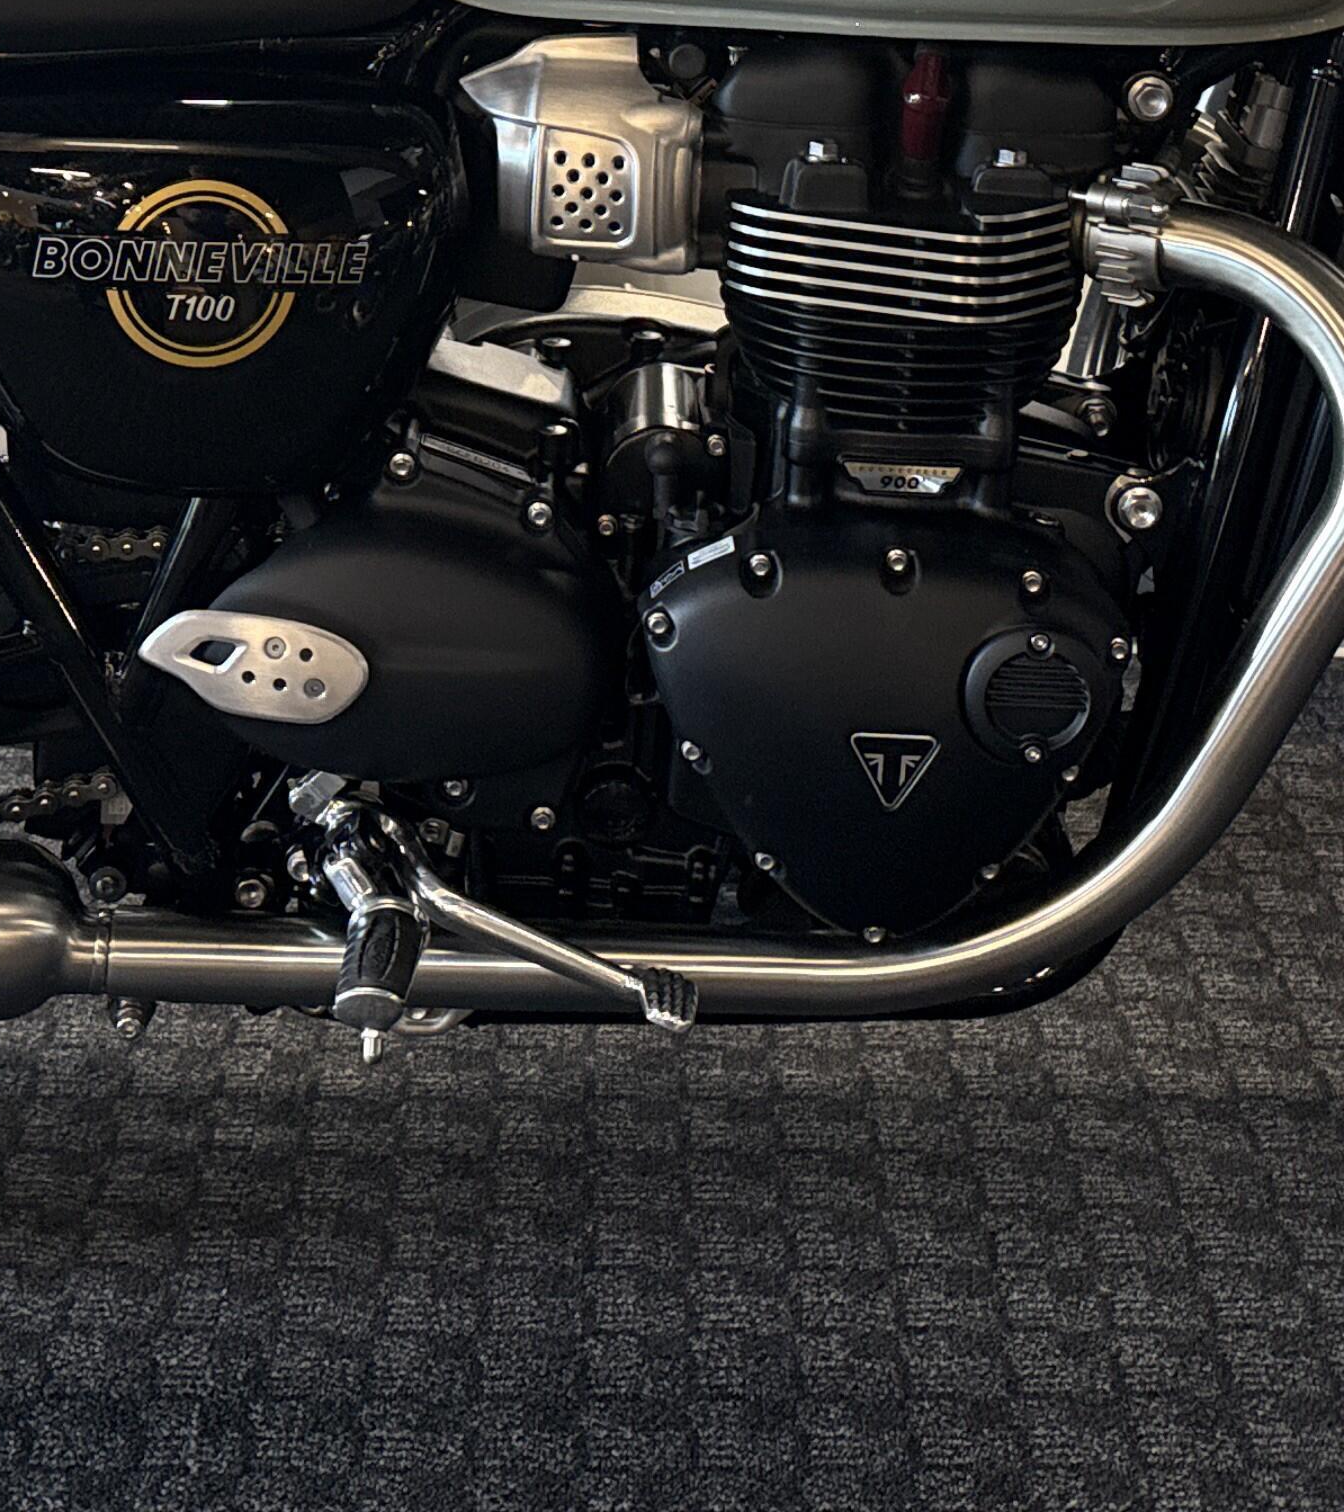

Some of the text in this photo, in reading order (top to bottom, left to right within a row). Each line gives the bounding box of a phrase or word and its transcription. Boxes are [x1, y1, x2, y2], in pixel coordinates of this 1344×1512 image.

[31, 235, 371, 285] BONNEVILLE
[164, 293, 236, 322] T100
[880, 475, 920, 490] 900
